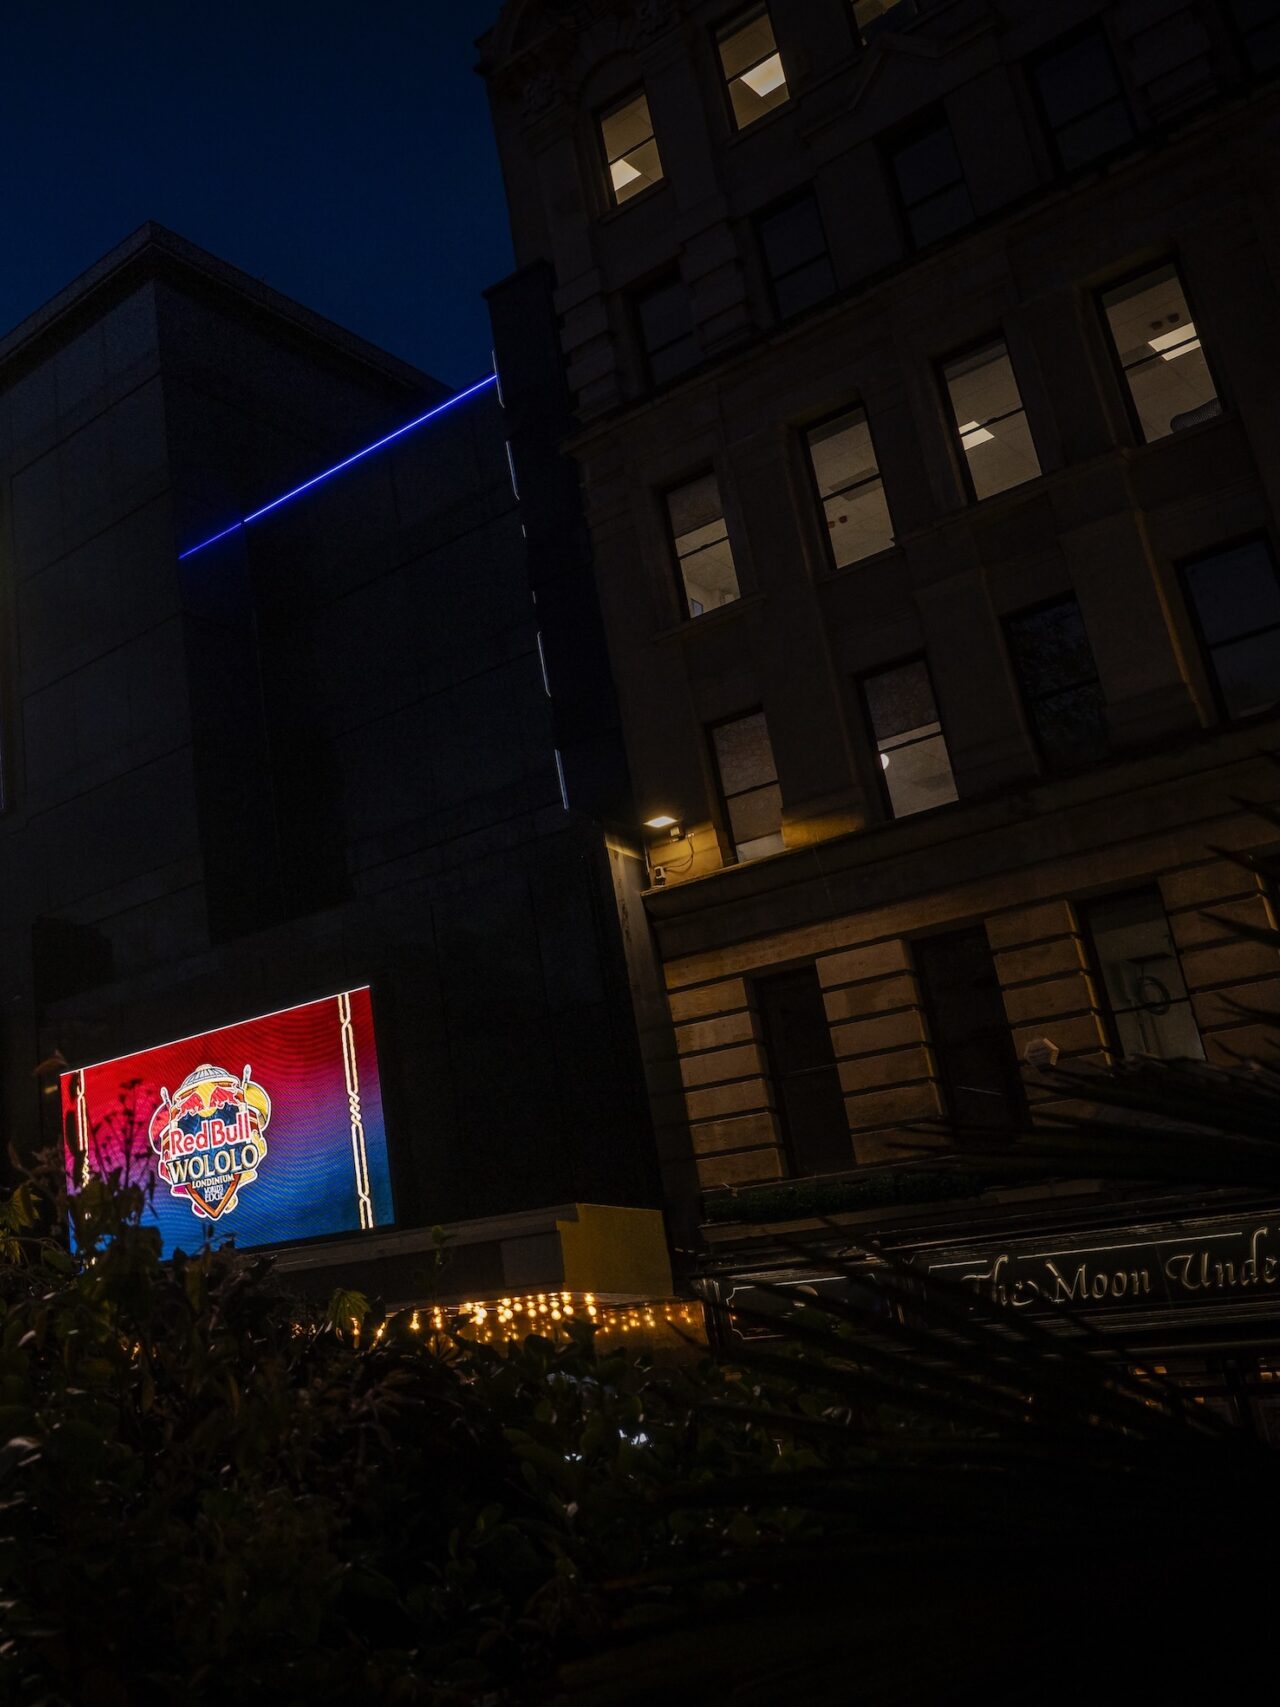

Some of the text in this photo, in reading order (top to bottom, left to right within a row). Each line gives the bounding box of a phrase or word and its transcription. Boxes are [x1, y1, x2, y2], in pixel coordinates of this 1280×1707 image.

[170, 1112, 250, 1155] Red Bull
[167, 1144, 259, 1184] WOLOLO
[192, 1173, 235, 1189] LONDINIUM
[1044, 1259, 1151, 1304] Moon
